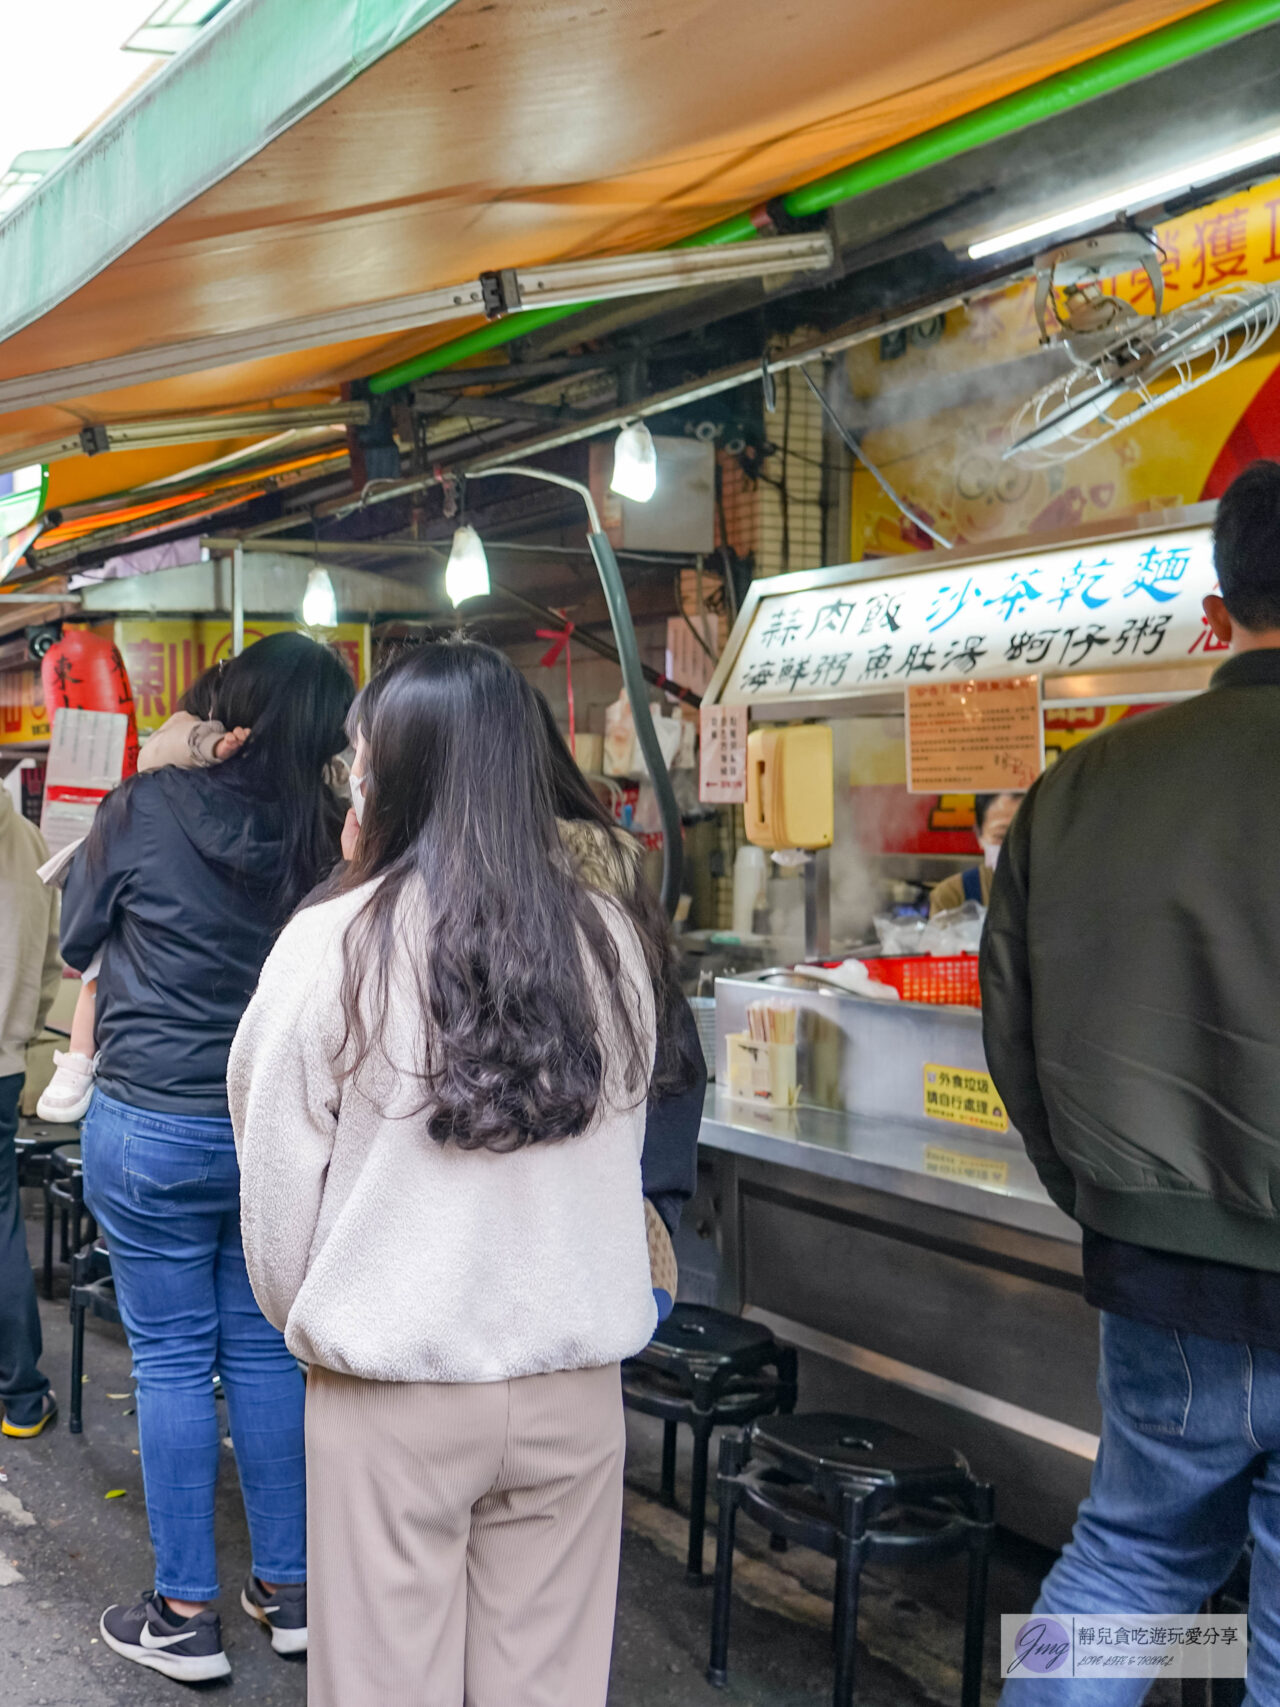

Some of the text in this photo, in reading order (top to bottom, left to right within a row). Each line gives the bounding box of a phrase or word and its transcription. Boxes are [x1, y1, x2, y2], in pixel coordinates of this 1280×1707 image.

[925, 545, 1193, 633] 沙茶乾麵
[740, 651, 853, 694] 海鮮粥
[856, 635, 987, 681] 魚肚湯
[1003, 613, 1174, 667] 蚵仔粥
[927, 1090, 988, 1116] 請自行處理
[939, 1072, 989, 1094] 外食垃圾
